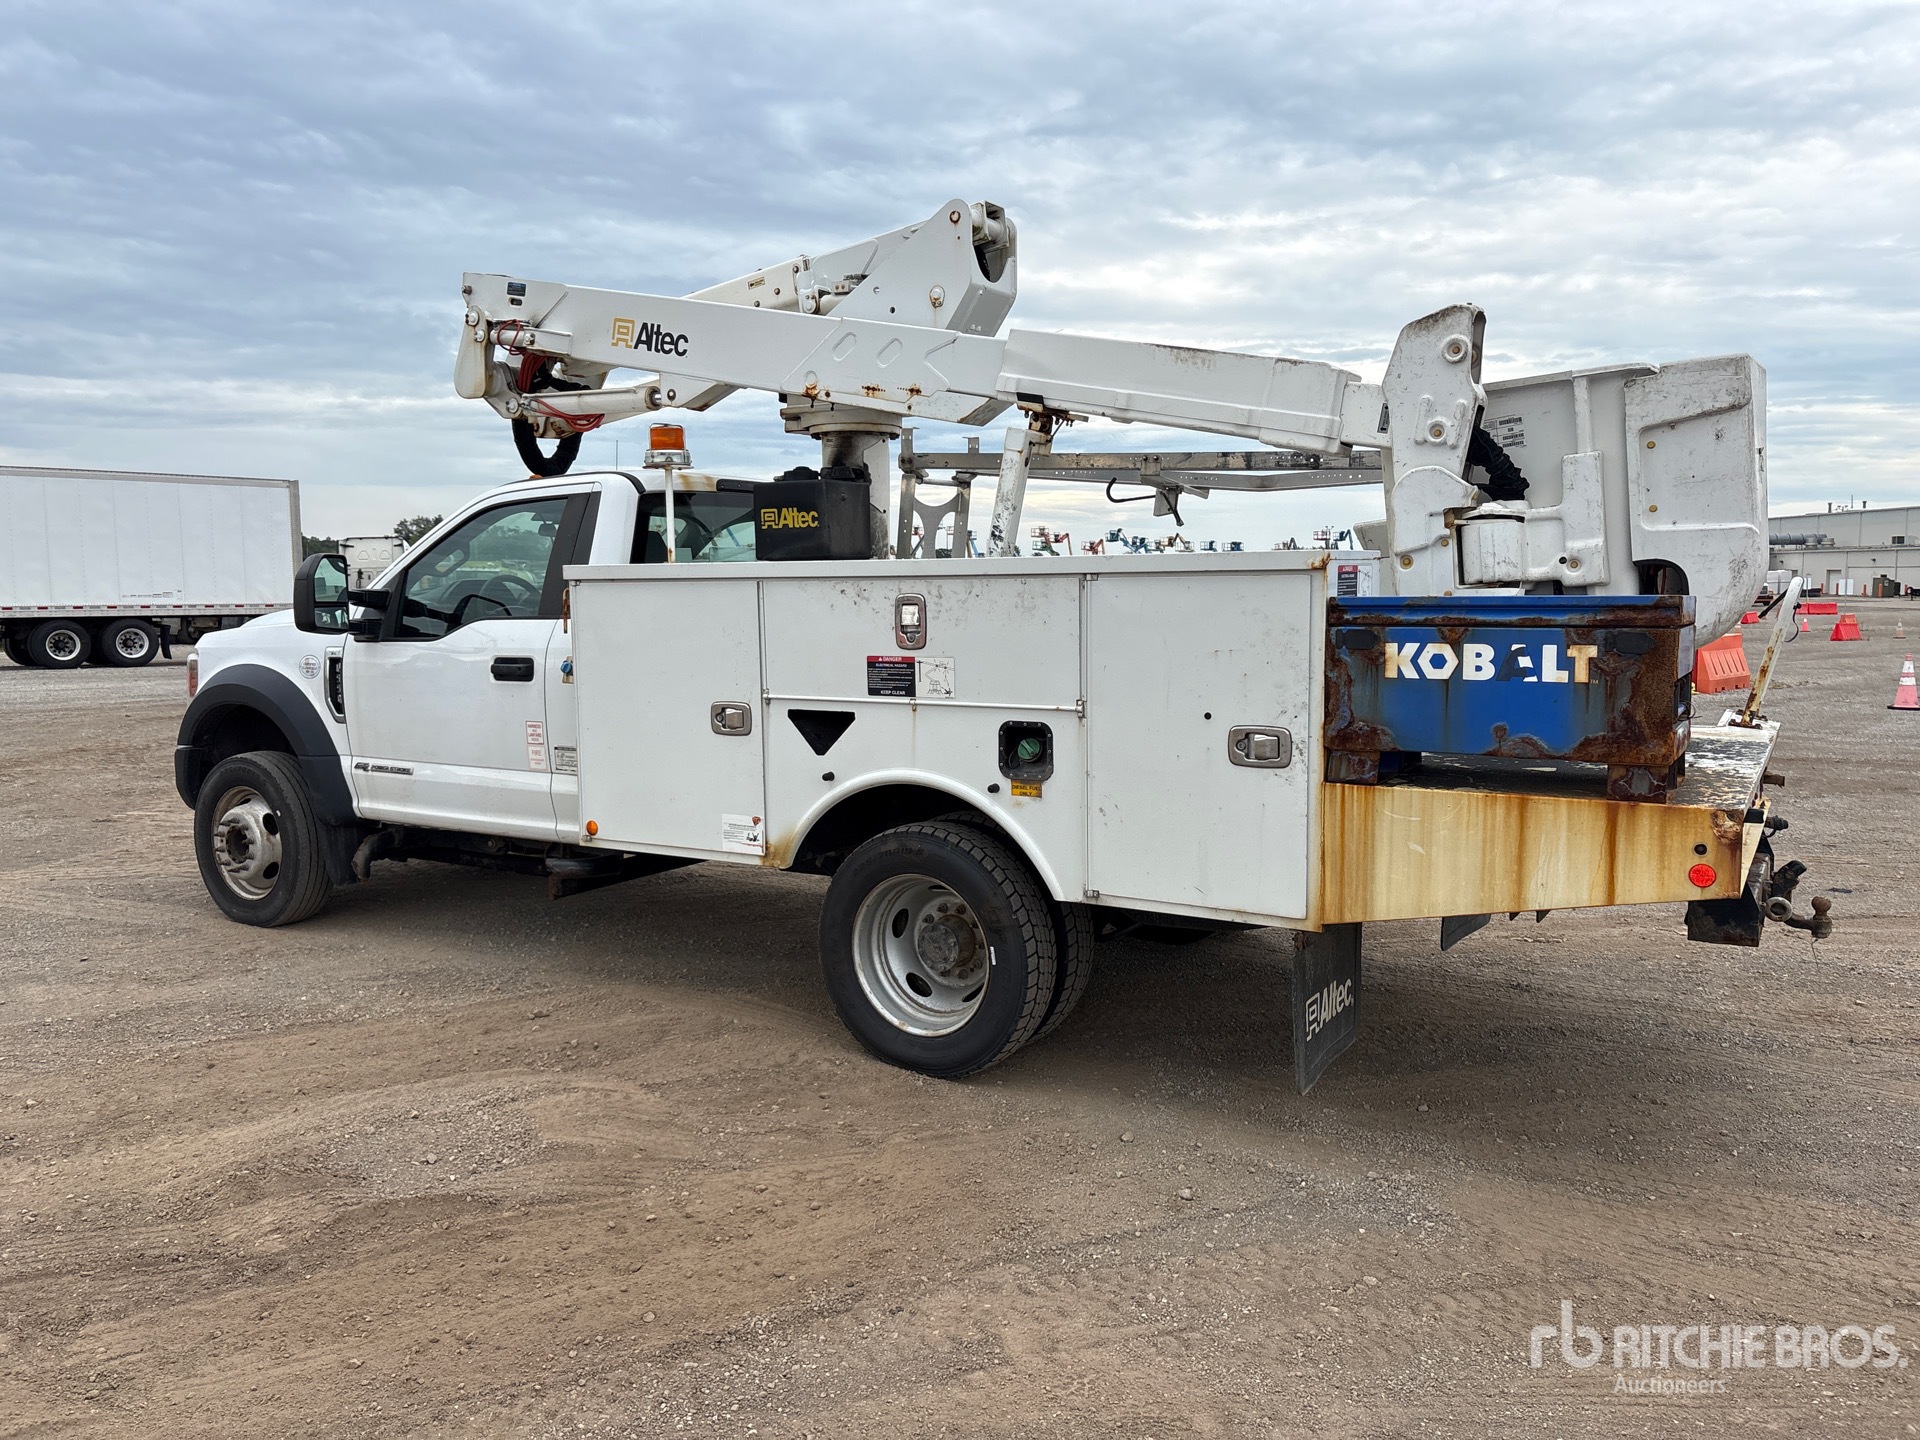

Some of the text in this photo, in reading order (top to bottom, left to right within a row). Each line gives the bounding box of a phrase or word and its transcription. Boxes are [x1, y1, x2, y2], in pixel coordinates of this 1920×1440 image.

[633, 322, 689, 357] Altec
[779, 507, 819, 528] Altec
[1384, 642, 1598, 683] KOBALT
[1320, 978, 1352, 1029] Altec
